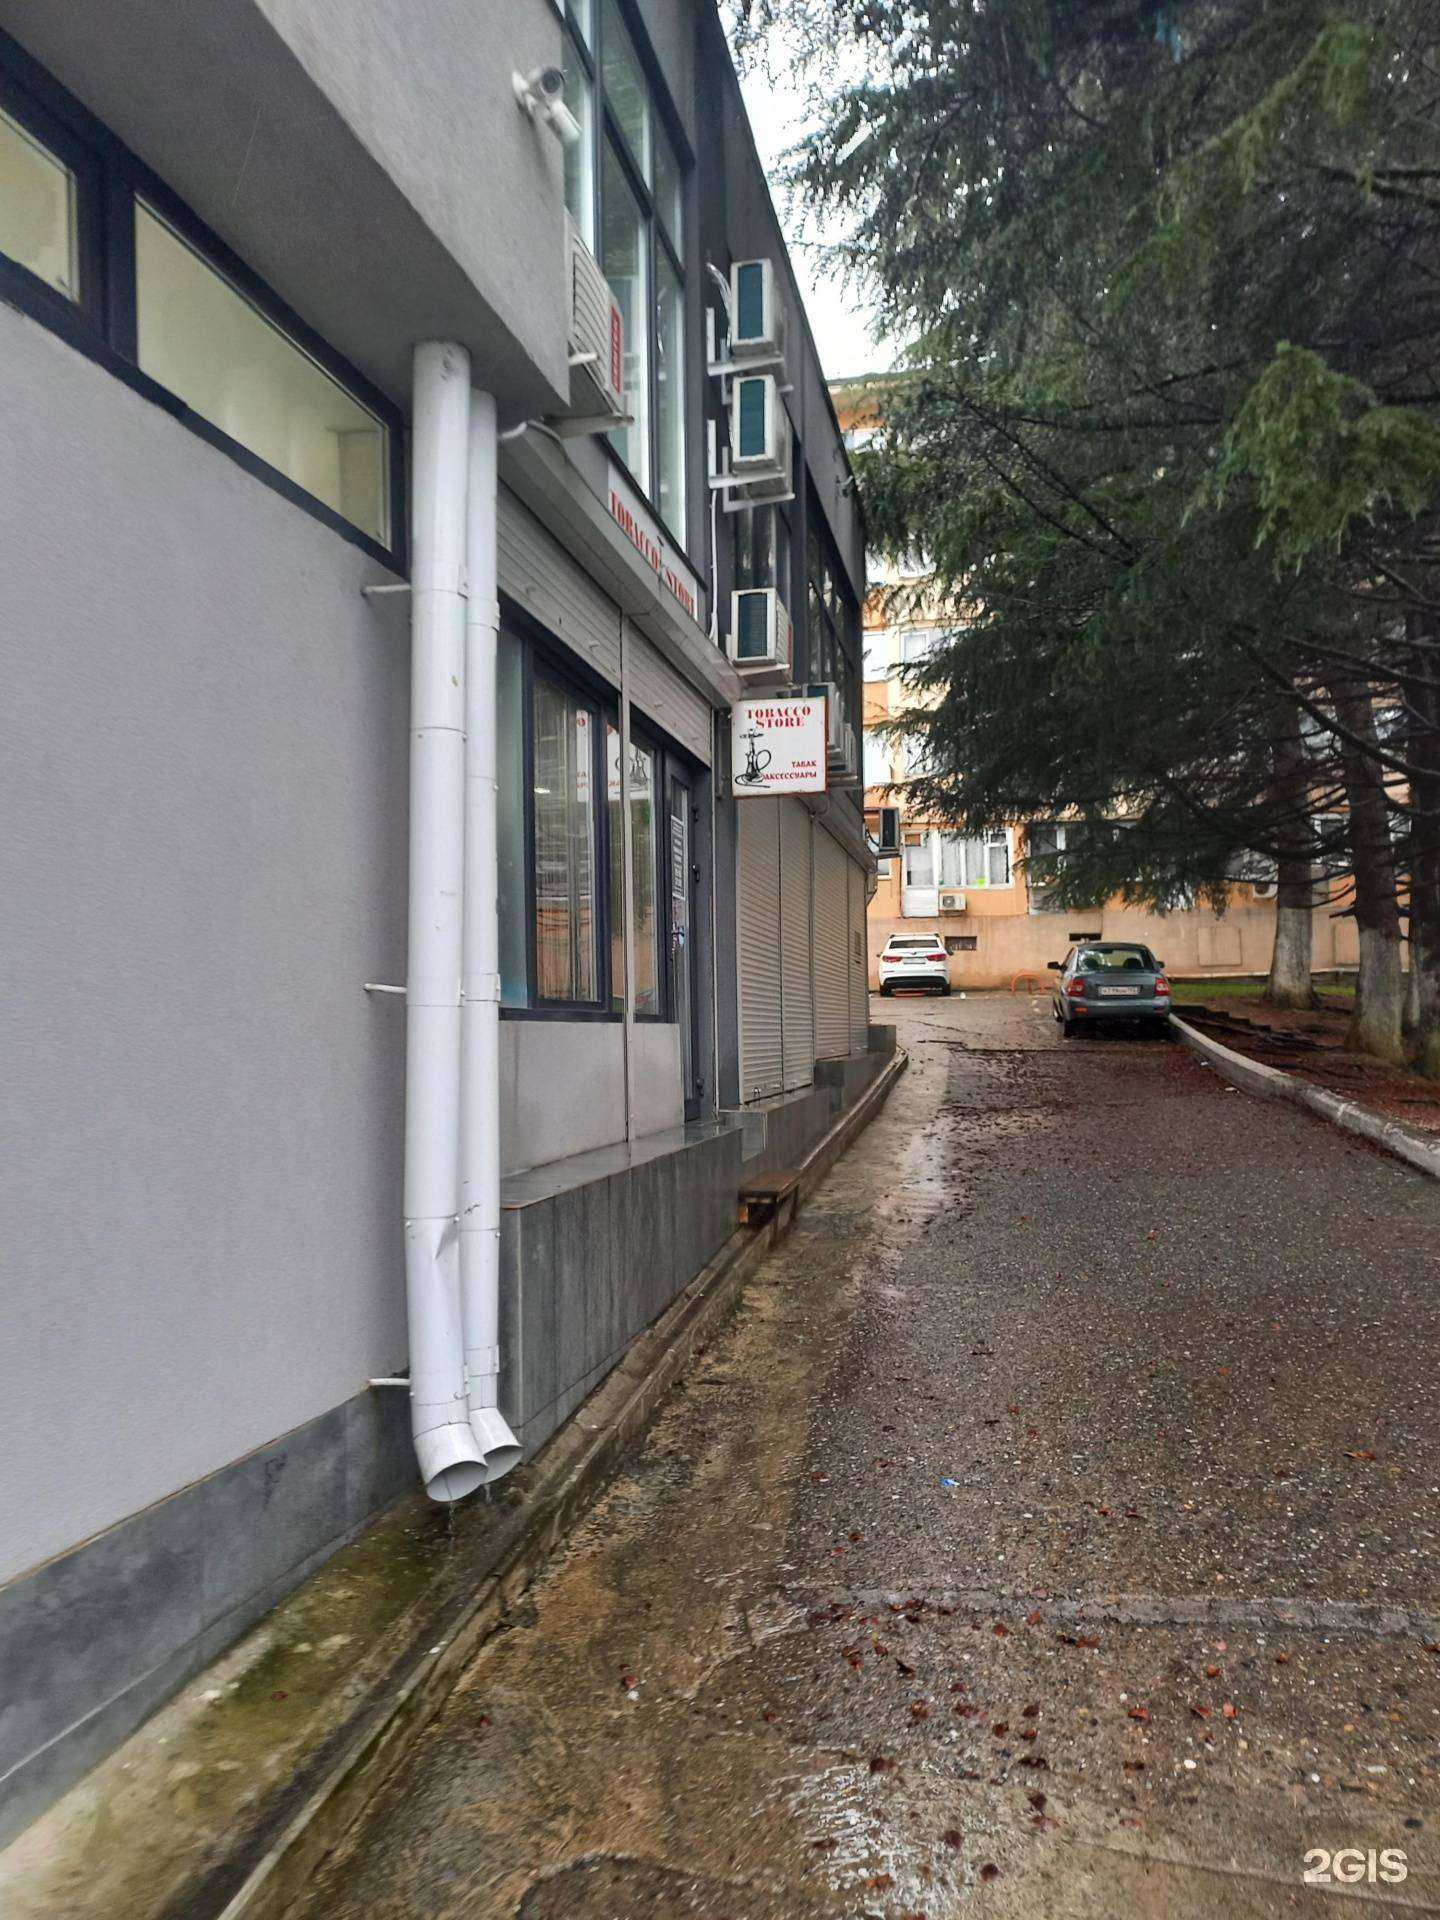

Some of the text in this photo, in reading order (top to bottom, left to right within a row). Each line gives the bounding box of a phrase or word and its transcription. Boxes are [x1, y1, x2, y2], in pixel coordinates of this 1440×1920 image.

[610, 490, 660, 572] TOBACCO
[745, 706, 811, 719] TOBACCO
[756, 717, 804, 728] STORE
[791, 760, 817, 769] ТАБАК
